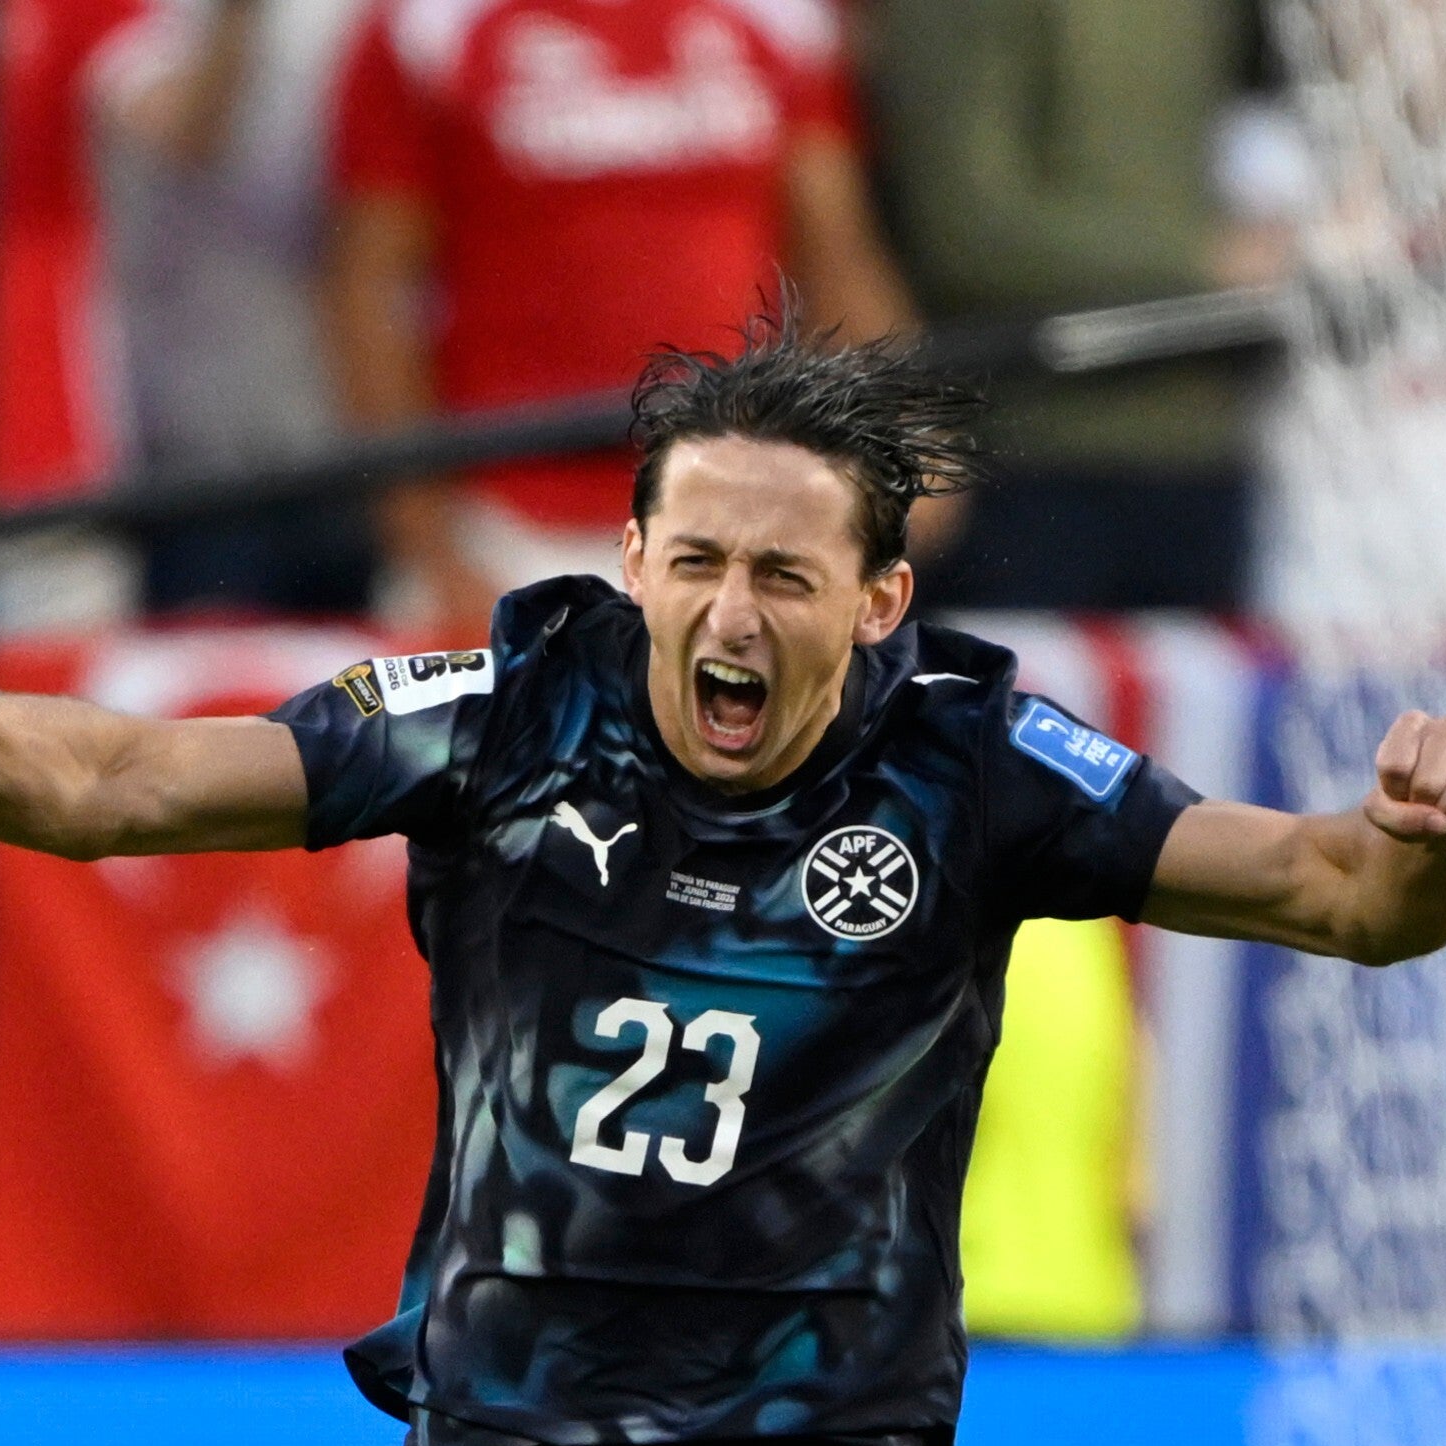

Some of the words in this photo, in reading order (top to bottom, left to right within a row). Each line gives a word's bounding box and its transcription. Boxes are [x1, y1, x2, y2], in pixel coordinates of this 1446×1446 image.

[353, 677, 378, 707] DEBUT
[839, 835, 877, 855] APF
[834, 916, 888, 935] PARAGUAY
[569, 997, 761, 1187] 23
